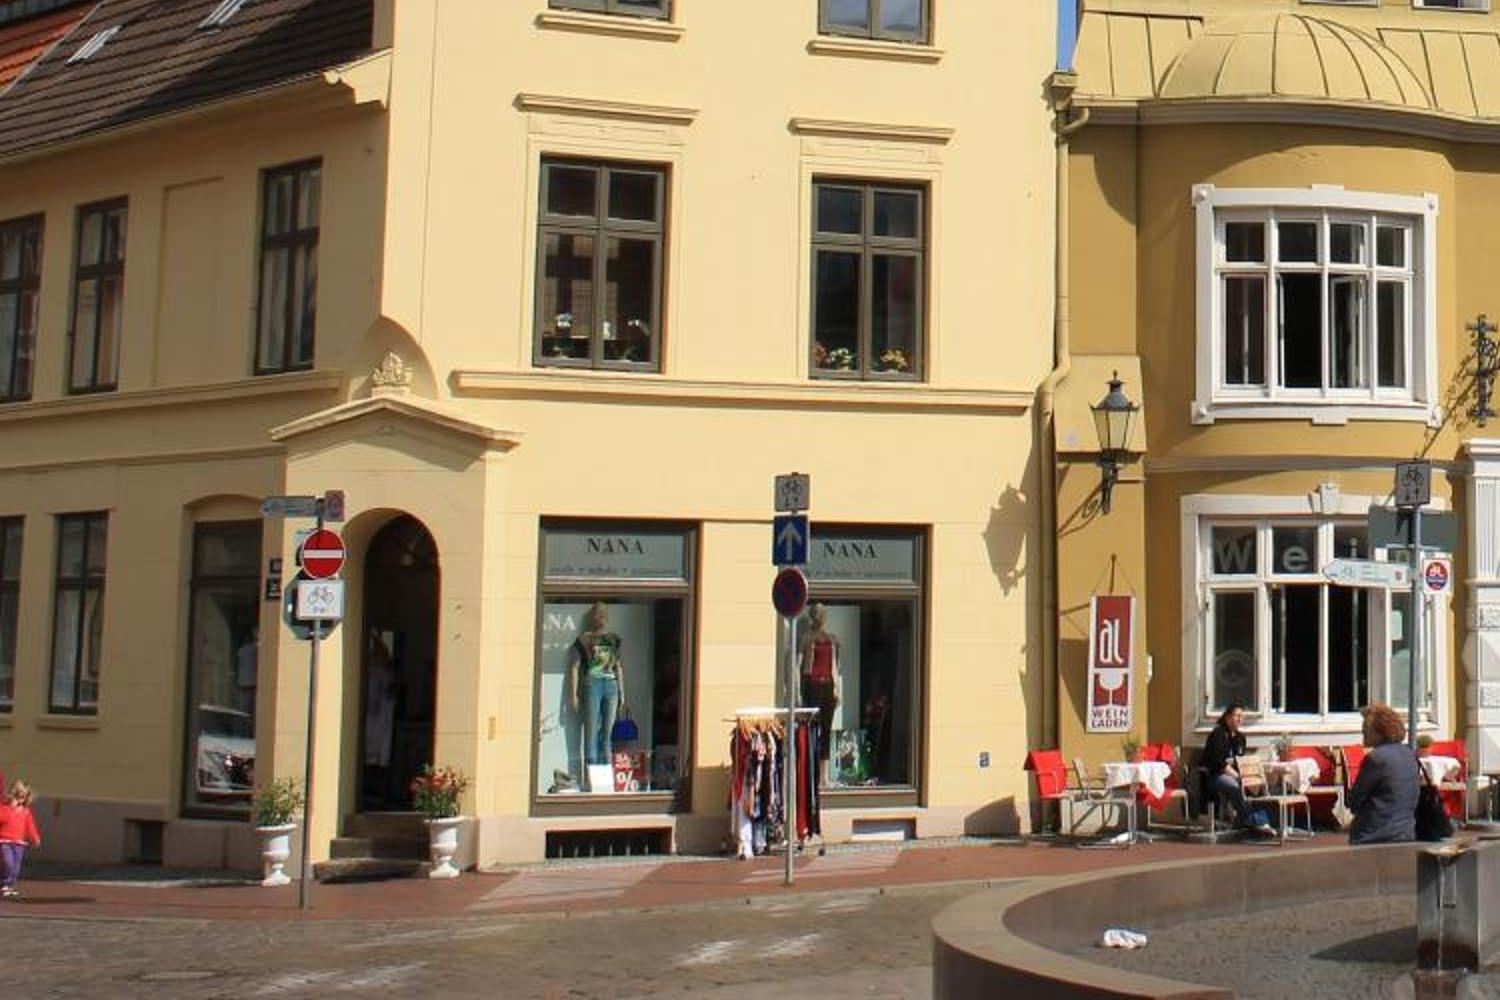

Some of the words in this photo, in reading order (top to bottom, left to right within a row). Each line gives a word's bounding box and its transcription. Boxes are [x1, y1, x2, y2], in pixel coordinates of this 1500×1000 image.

[587, 538, 645, 555] NANA
[823, 541, 878, 559] NANA
[1091, 709, 1129, 719] WEIN
[1091, 719, 1129, 729] LADEN
